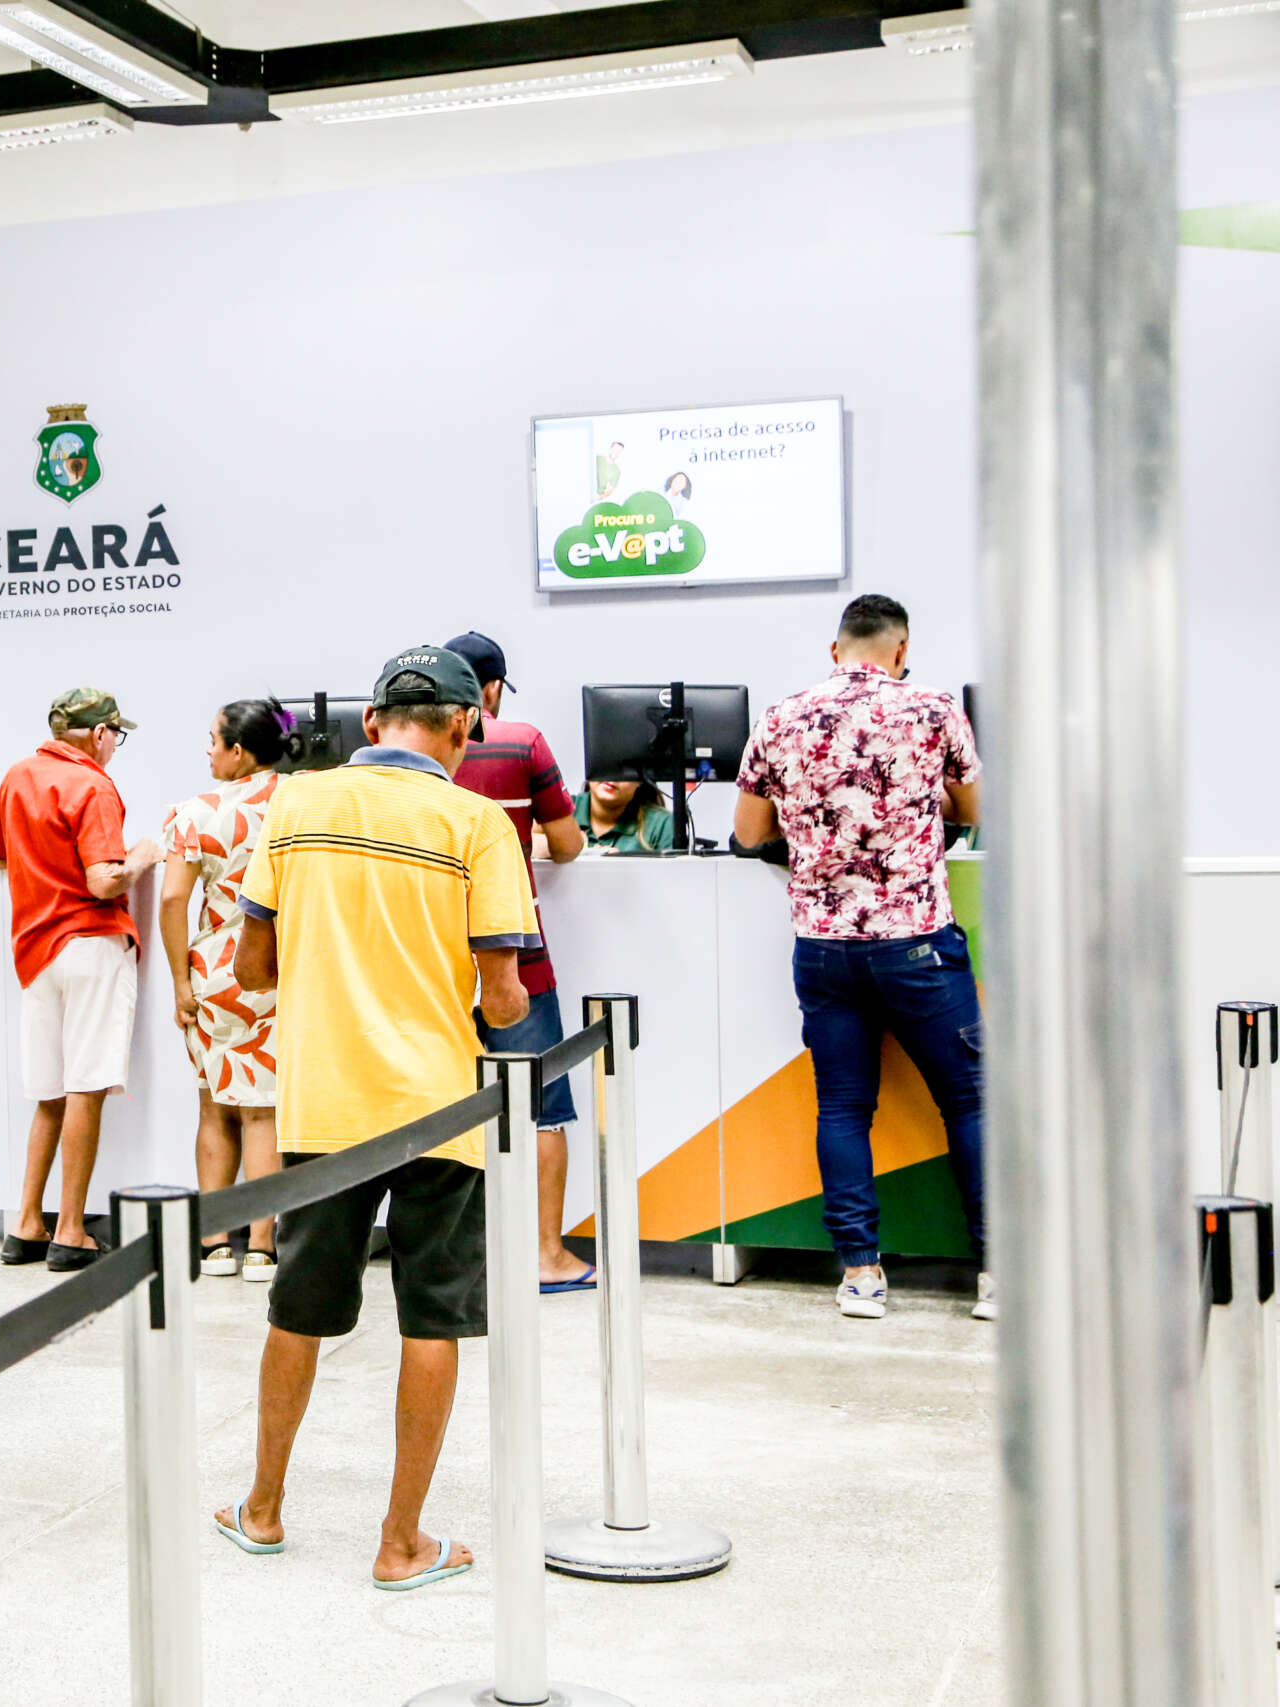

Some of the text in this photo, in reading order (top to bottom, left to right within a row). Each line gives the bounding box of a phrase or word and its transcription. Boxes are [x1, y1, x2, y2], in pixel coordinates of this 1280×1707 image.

[659, 420, 816, 441] Precisa de acesso
[703, 444, 786, 462] internet?
[646, 514, 656, 525] o
[568, 525, 685, 566] e-V@pt
[68, 578, 96, 593] DO
[103, 574, 181, 592] ESTADO
[45, 607, 60, 617] DA
[63, 602, 126, 618] PROTEÇÃO
[129, 603, 172, 614] SOCIAL
